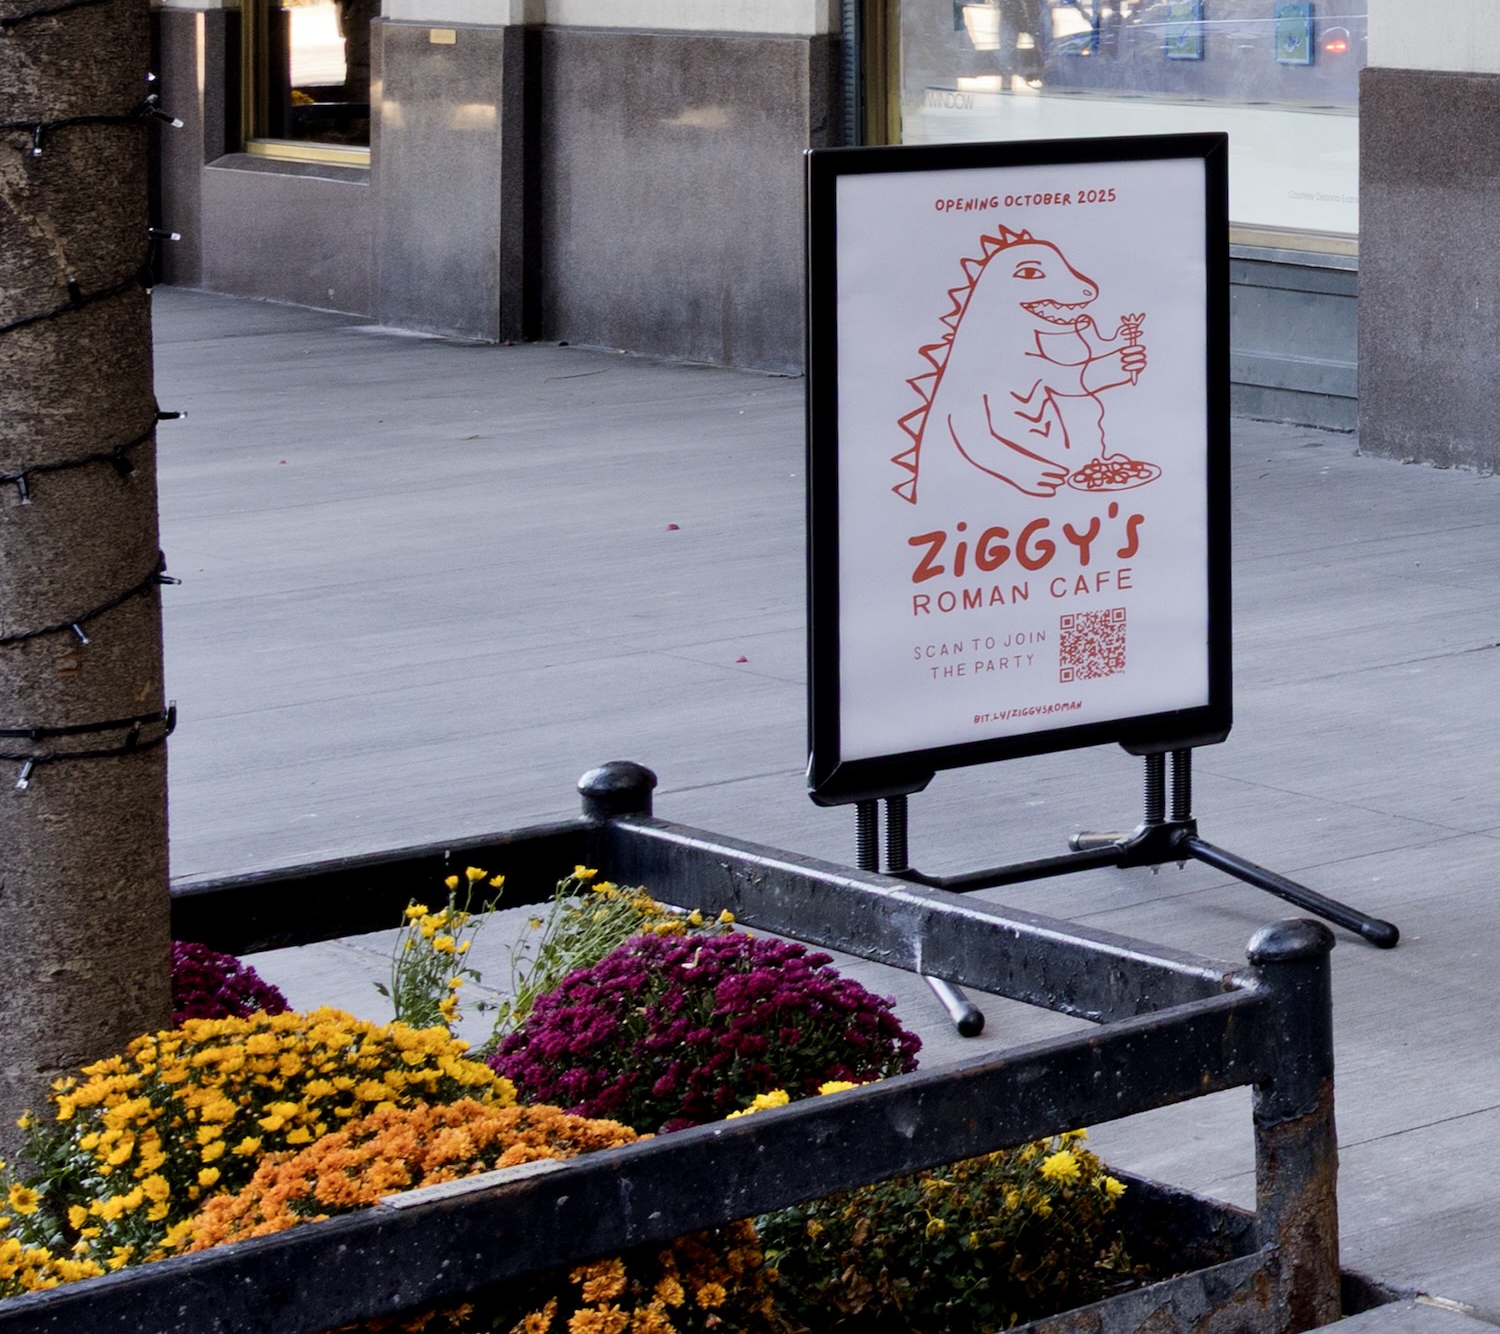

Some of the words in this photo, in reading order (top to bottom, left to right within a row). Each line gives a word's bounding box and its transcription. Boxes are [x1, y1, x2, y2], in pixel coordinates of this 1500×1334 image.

[935, 196, 999, 213] OPENING
[1004, 192, 1072, 208] OCTOBER
[1077, 188, 1116, 204] 2025
[912, 581, 1030, 617] ROMAN
[1050, 568, 1133, 599] CAFE
[913, 641, 964, 660] SCAN
[972, 636, 996, 651] TO
[1004, 630, 1047, 648] JOIN
[930, 663, 966, 680] THE
[974, 654, 1035, 674] PARTY
[973, 699, 1083, 725] BIT.LY/ZIGGYSROMAN
